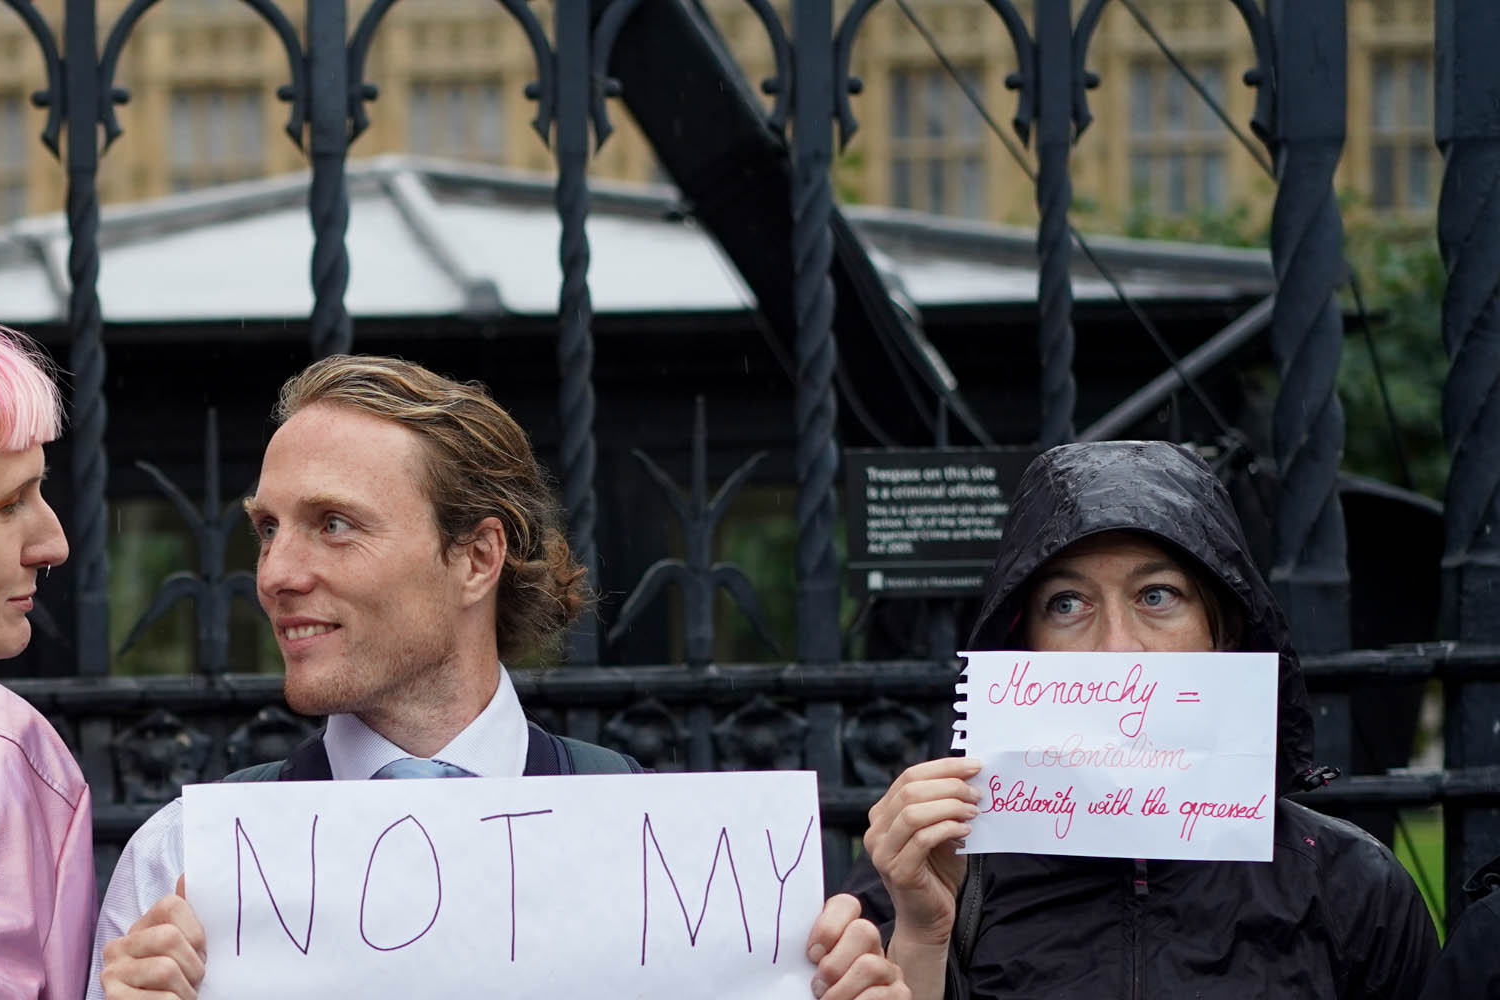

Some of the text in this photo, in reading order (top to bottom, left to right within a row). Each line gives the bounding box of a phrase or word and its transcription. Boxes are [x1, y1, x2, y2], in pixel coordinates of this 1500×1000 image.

[867, 466, 996, 483] Trespass on this site
[891, 484, 946, 499] criminal
[988, 660, 1158, 738] Monarchy
[1024, 733, 1192, 771] colonialism
[981, 775, 1077, 839] Solidarity
[1088, 788, 1132, 816] with
[1141, 786, 1170, 817] the
[236, 809, 815, 966] NOT MY
